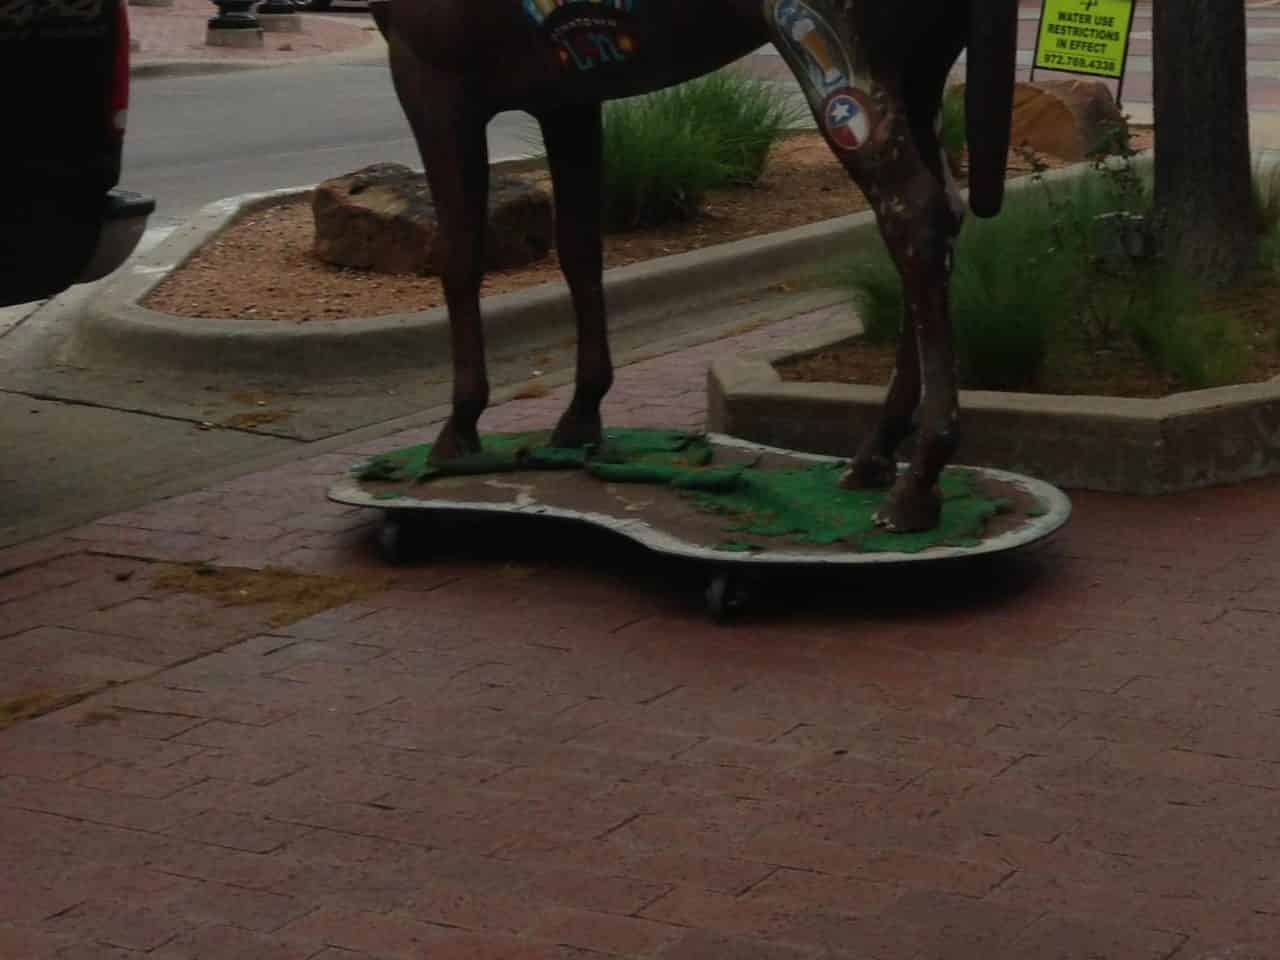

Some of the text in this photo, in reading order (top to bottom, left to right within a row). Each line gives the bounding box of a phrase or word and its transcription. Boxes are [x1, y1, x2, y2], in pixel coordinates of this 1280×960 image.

[1058, 11, 1115, 27] WATER USE
[1048, 24, 1119, 41] RESTRICTIONS
[1056, 39, 1107, 54] IN EFFECT
